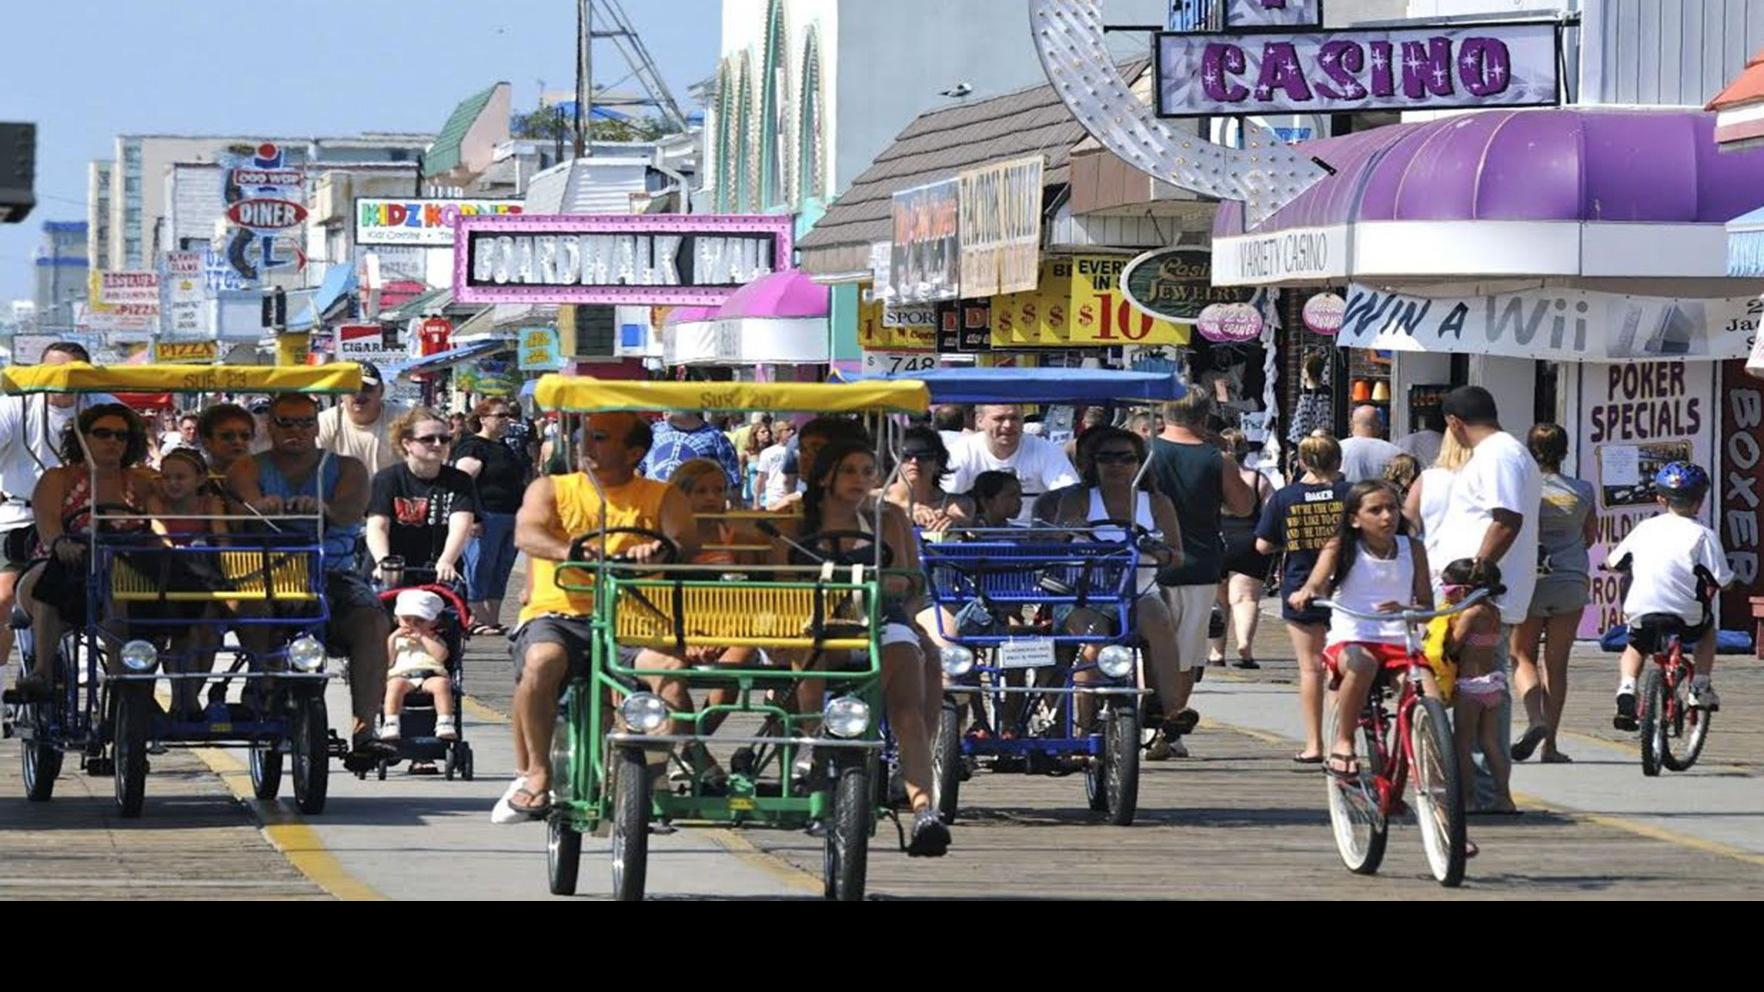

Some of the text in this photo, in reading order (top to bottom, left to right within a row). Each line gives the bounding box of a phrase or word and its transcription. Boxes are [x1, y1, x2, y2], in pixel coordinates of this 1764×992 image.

[1202, 37, 1510, 102] CASINO
[240, 203, 296, 225] DINER
[361, 203, 422, 228] KIDZ
[474, 235, 771, 286] BOARDWALK MALL
[1240, 232, 1328, 278] VARIETY CASINO
[1093, 276, 1111, 290] IN
[1341, 292, 1431, 338] WIN
[1437, 301, 1469, 340] A
[1485, 296, 1587, 351] Wii
[160, 344, 214, 357] PIZZA
[228, 371, 246, 388] 23
[1608, 360, 1685, 401] POKER
[1590, 397, 1700, 443] SPECIALS
[1304, 490, 1334, 502] BAKER
[1727, 388, 1761, 586] BOXER
